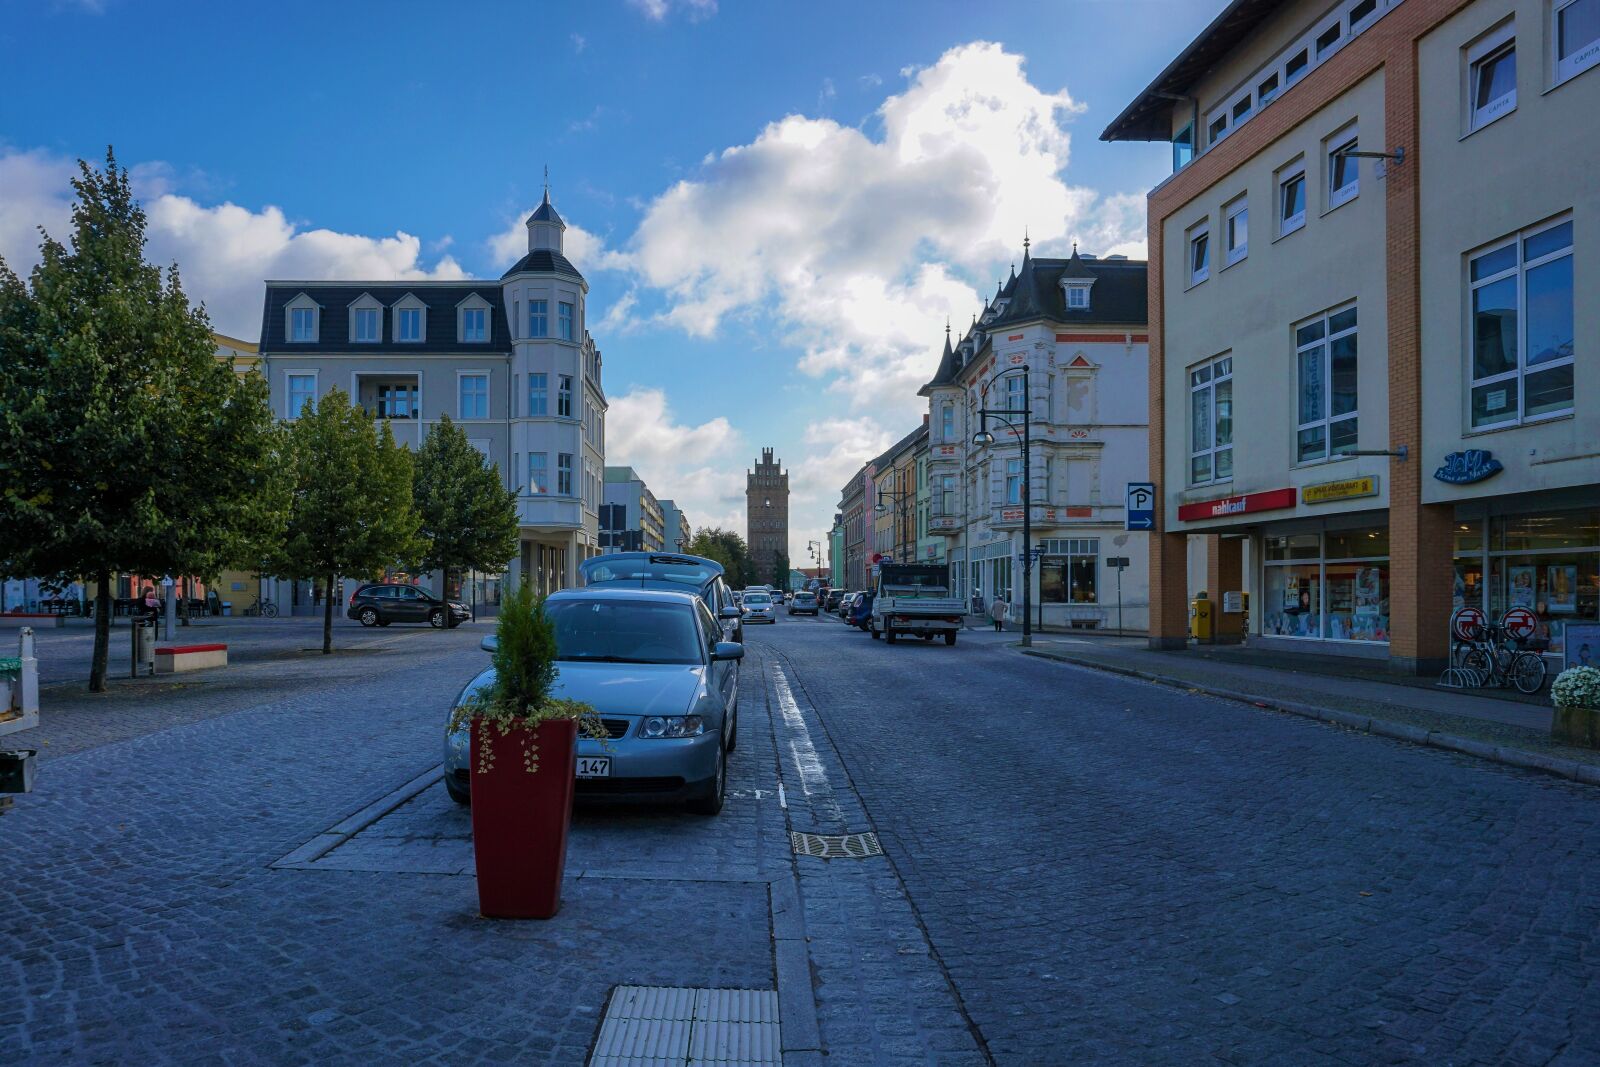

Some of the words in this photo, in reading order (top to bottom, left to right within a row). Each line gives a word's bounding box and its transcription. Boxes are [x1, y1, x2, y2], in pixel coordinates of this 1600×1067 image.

[1574, 46, 1600, 64] CAPITA
[1136, 494, 1147, 509] P
[1212, 497, 1246, 515] nahkauf
[580, 760, 608, 774] 147
